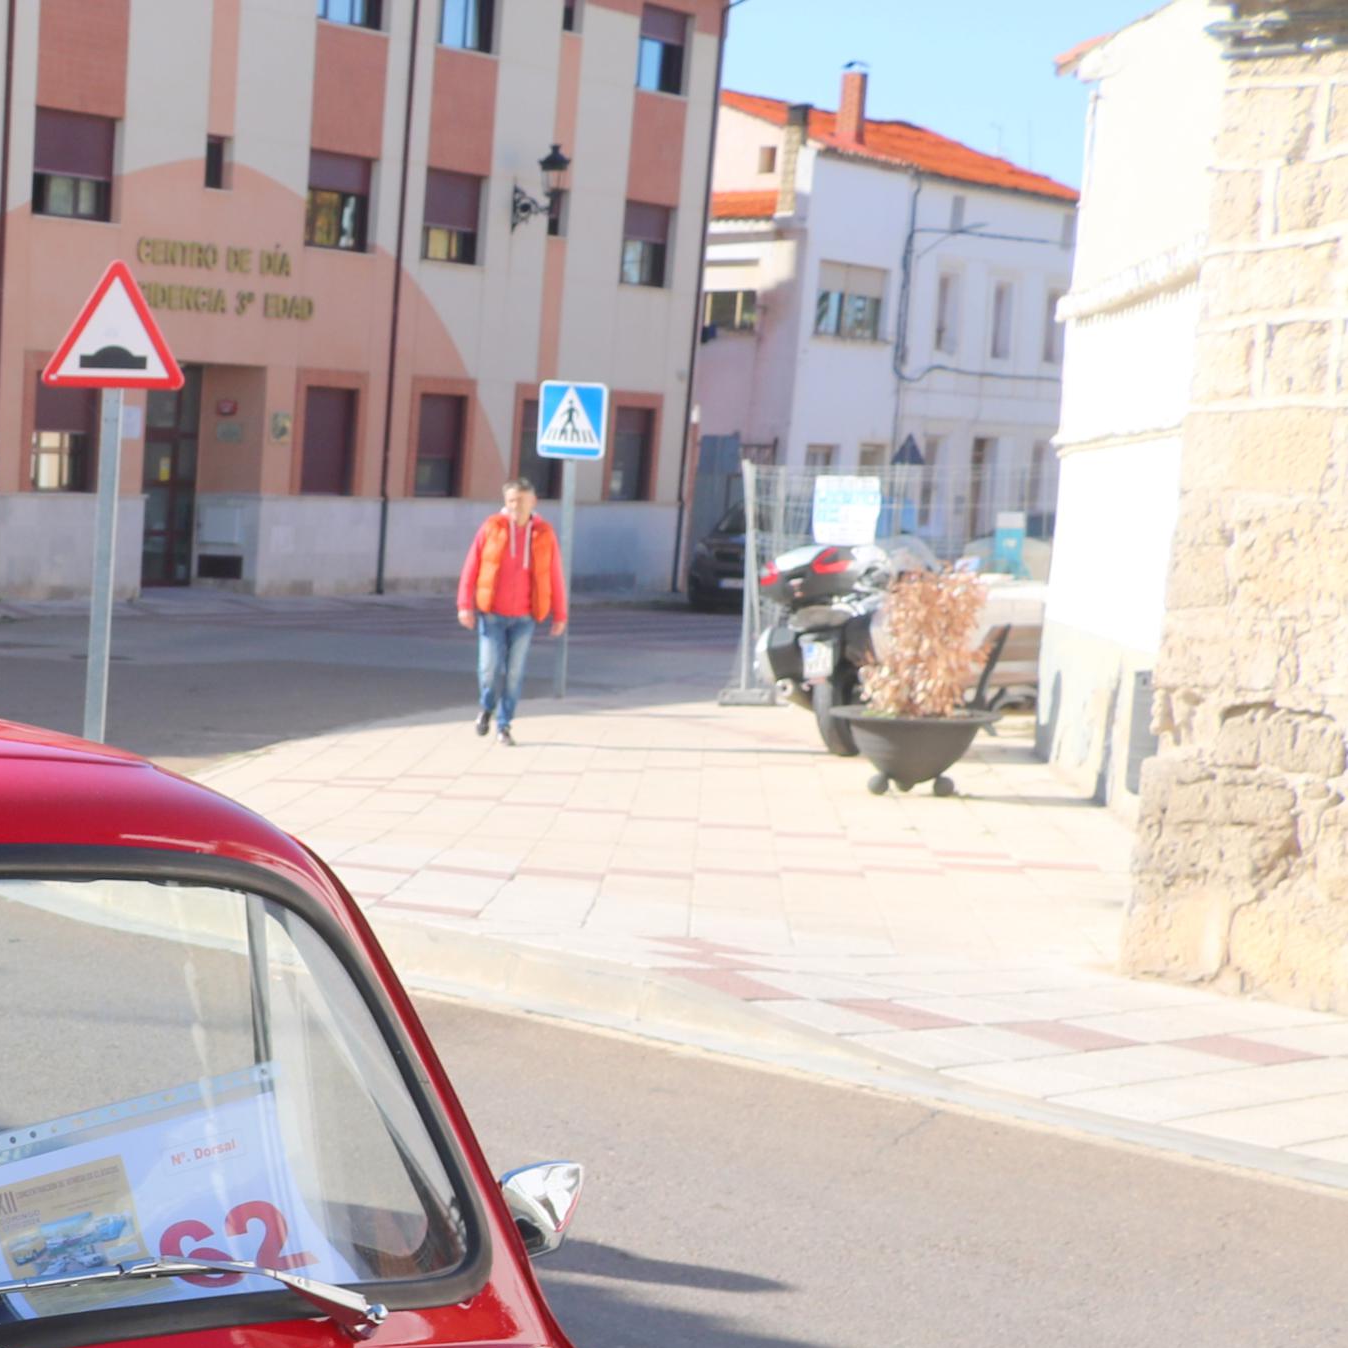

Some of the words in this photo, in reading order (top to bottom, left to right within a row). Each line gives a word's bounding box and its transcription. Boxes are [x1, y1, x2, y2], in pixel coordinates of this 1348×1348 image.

[137, 237, 218, 270] CENTRO
[226, 246, 251, 273] DE
[260, 243, 292, 277] DÍA
[264, 293, 314, 321] EDAD
[193, 1138, 237, 1160] Dorsal
[159, 1200, 320, 1288] 62
